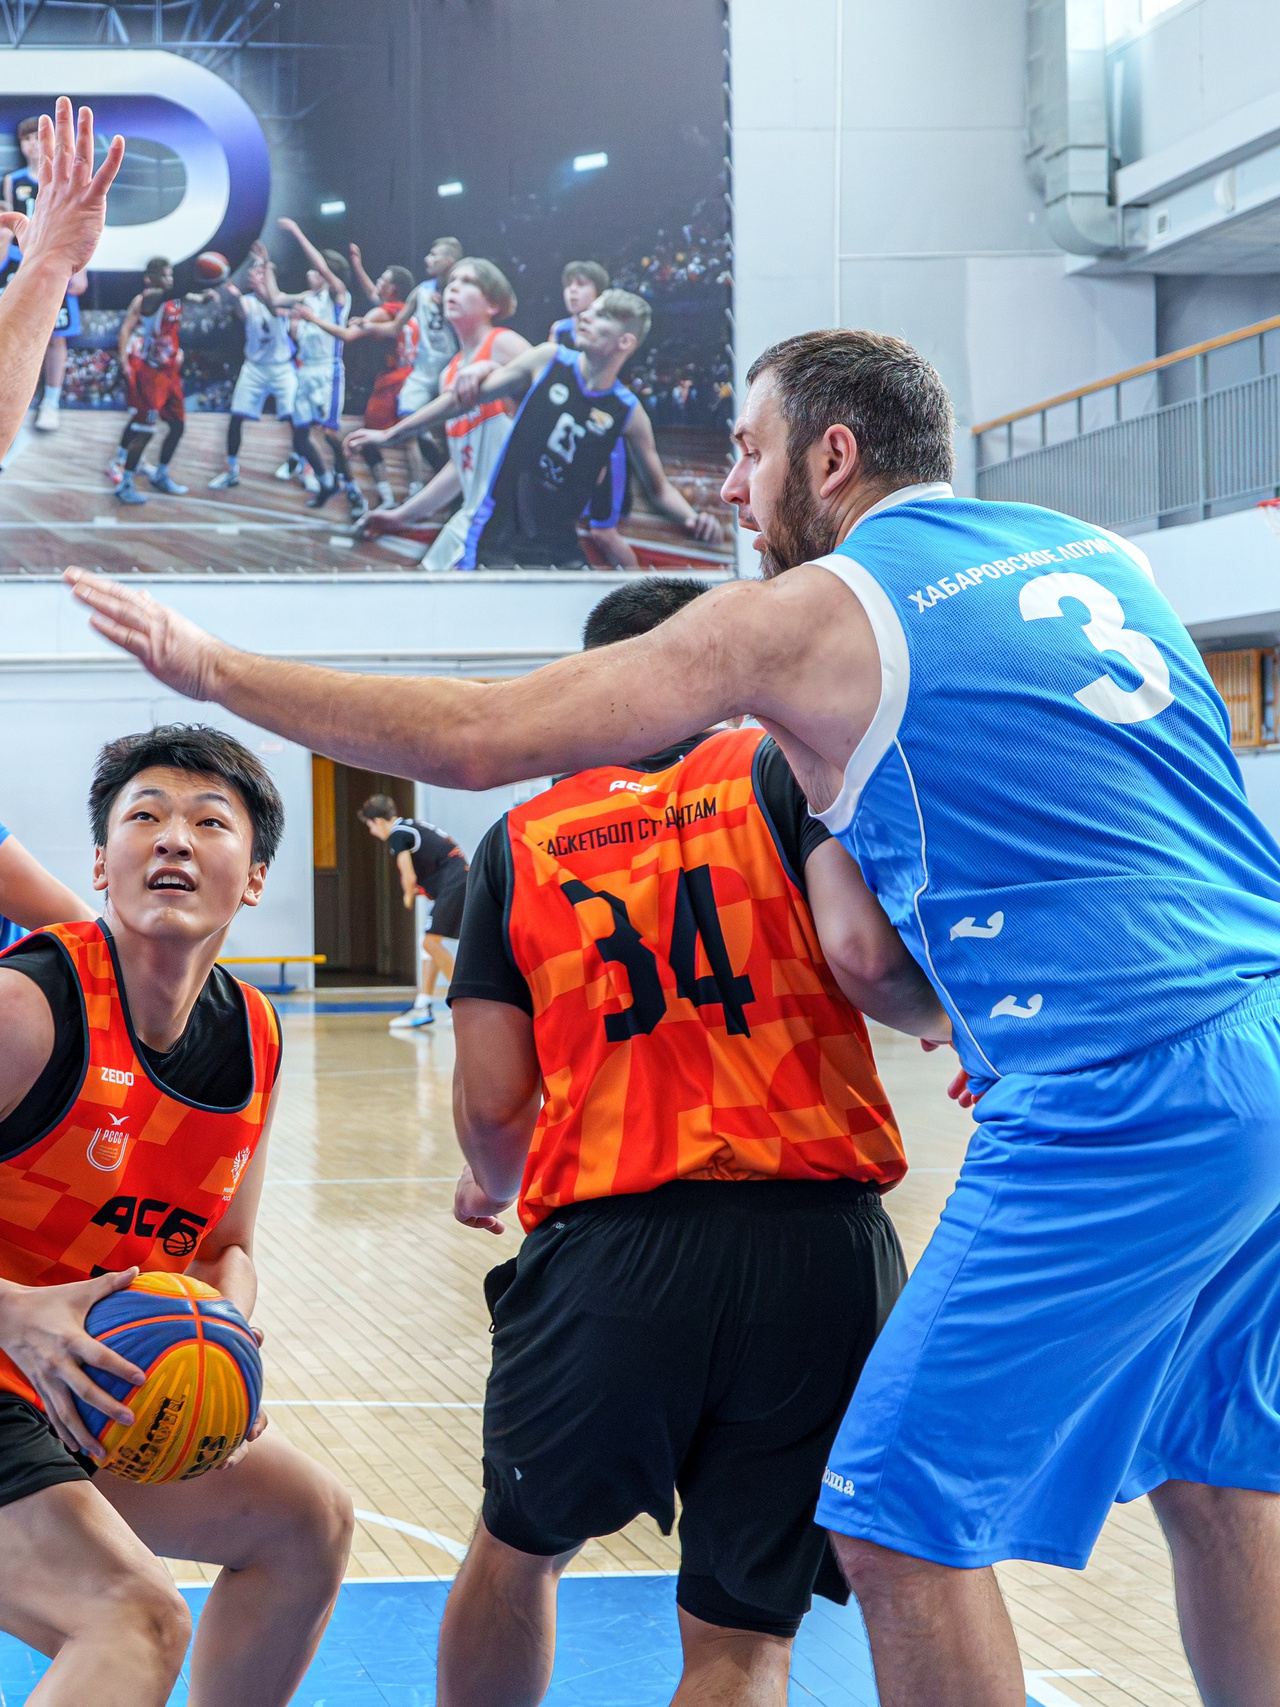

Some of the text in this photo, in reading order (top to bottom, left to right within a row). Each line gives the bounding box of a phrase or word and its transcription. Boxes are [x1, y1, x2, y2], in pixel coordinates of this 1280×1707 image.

[908, 549, 1064, 613] ХАБАРОВСКОЕ
[1019, 572, 1174, 724] 3
[561, 863, 756, 1043] 34
[101, 1066, 134, 1086] ZEDO
[90, 1196, 209, 1257] АСБ
[822, 1465, 855, 1497] oma
